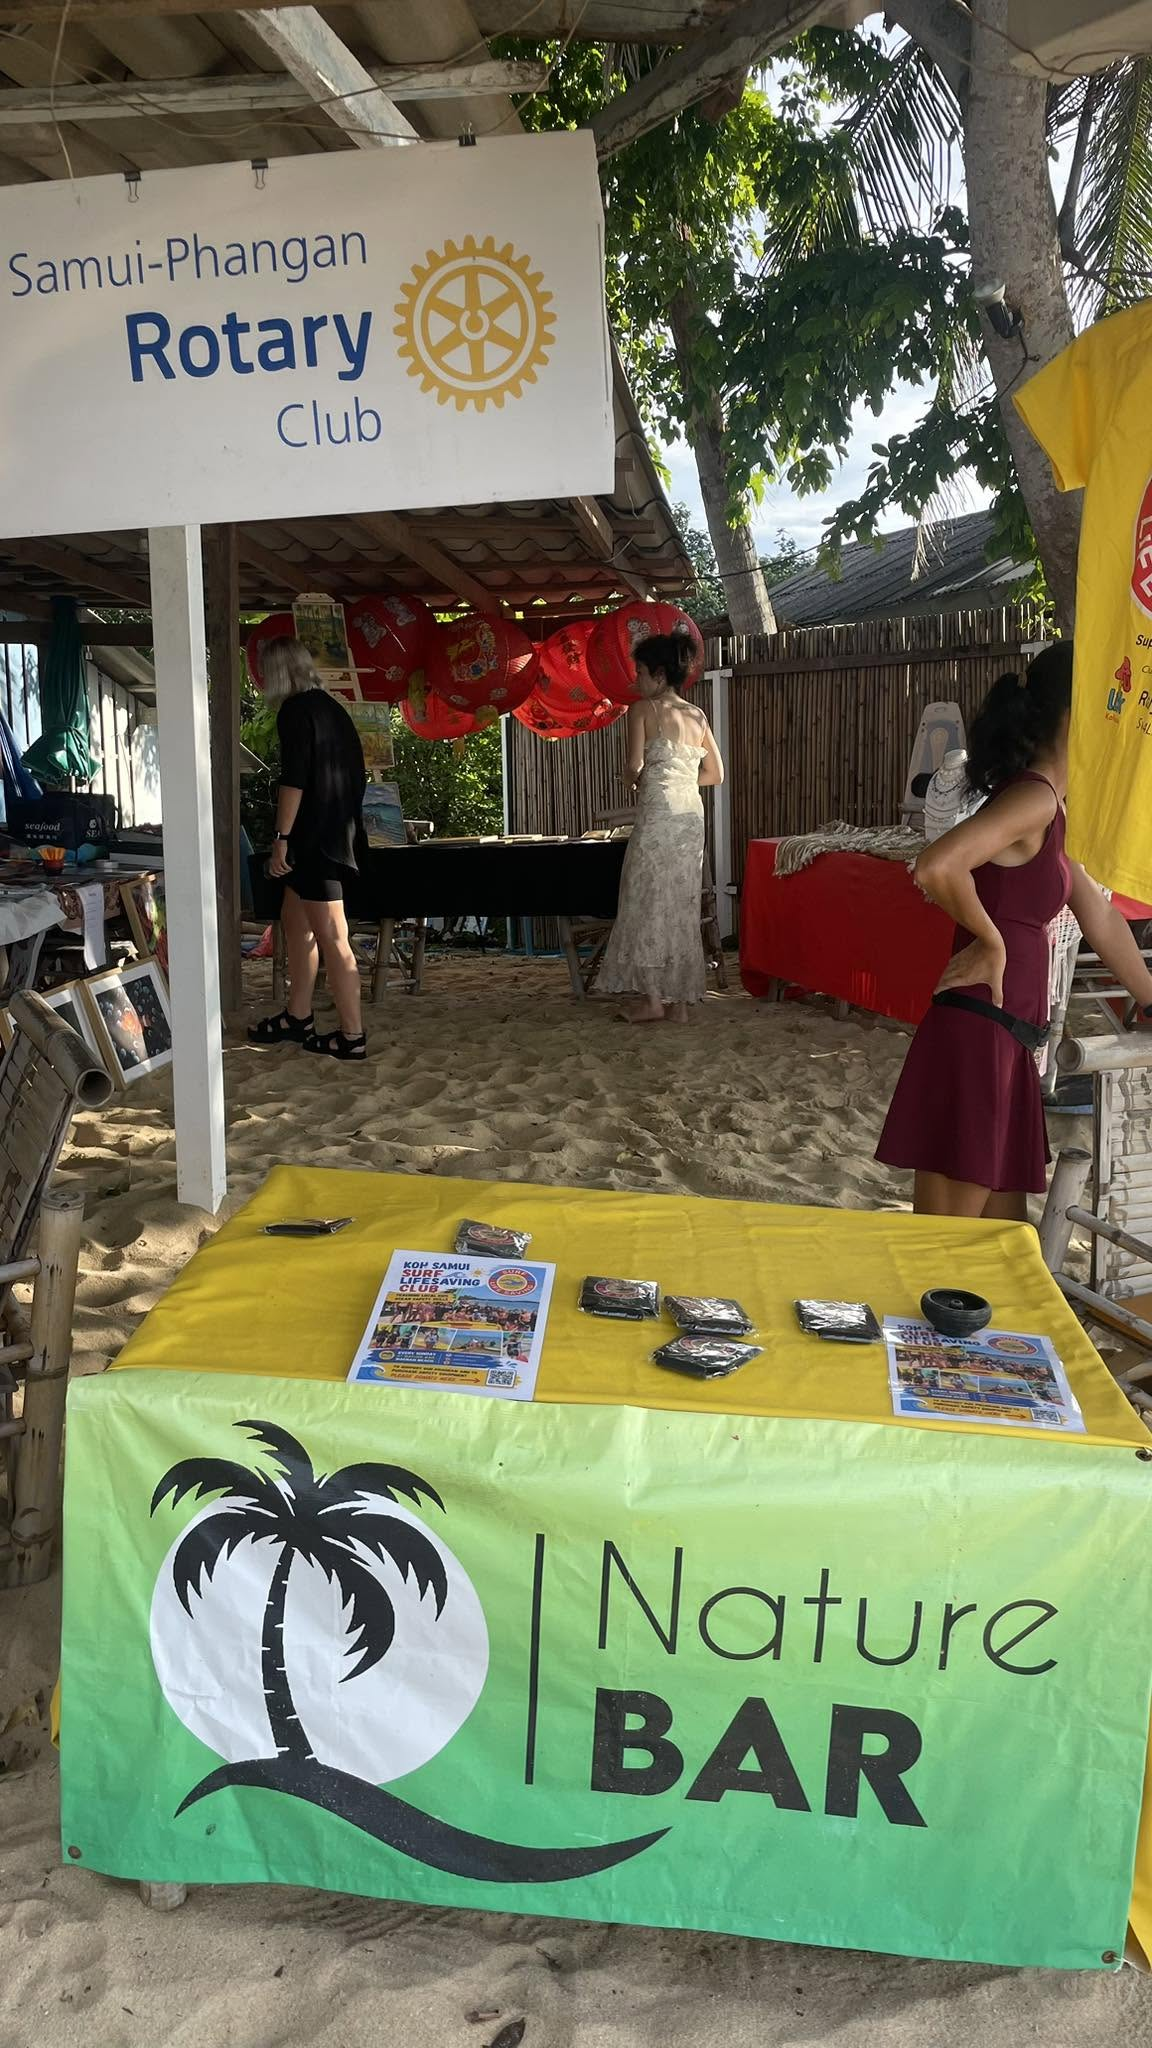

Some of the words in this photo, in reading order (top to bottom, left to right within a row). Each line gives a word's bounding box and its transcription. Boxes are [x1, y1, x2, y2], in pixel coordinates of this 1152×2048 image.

[8, 232, 367, 297] Samui-Phangan
[125, 311, 373, 382] Rotary
[276, 396, 382, 448] Club
[25, 822, 61, 832] seafood
[402, 1269, 444, 1278] SURF
[403, 1261, 429, 1269] KOH
[431, 1262, 470, 1271] SAMUI
[399, 1284, 439, 1293] CLUB
[400, 1277, 481, 1287] LIFESAVING
[598, 1540, 1059, 1676] Nature
[591, 1687, 929, 1828] BAR
